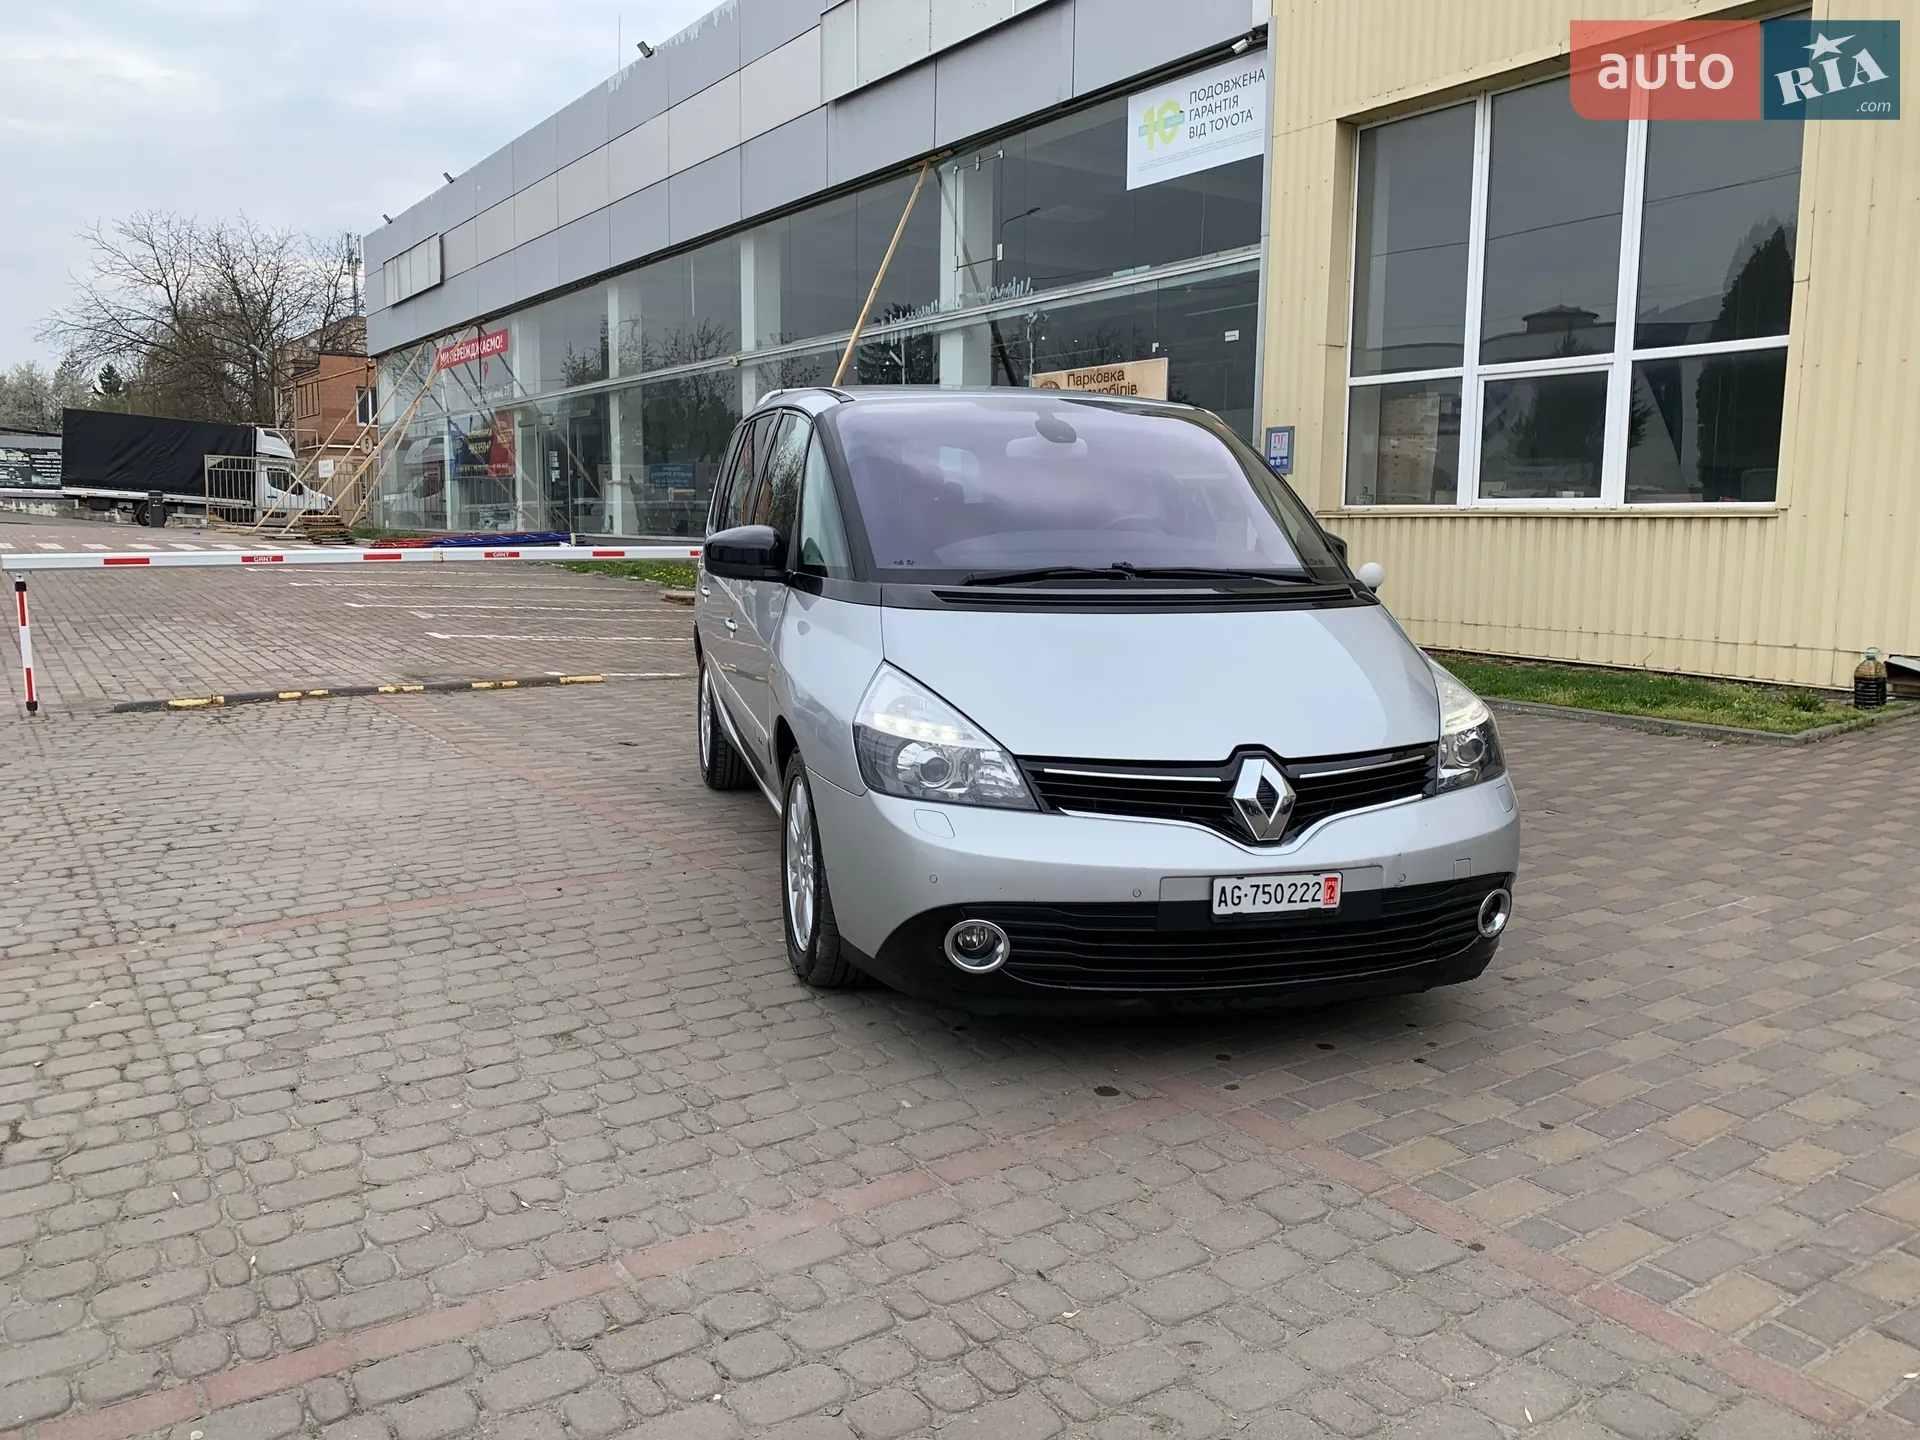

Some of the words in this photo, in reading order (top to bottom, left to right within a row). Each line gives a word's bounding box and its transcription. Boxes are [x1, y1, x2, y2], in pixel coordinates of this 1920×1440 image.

[1189, 68, 1266, 104] ПОДОВЖЕНА
[1189, 95, 1239, 122] ГАРАНТІЯ
[1188, 123, 1206, 139] ВІД
[1209, 109, 1253, 133] TOYOTA
[1067, 370, 1125, 388] Парковка
[1274, 434, 1287, 444] ПГ
